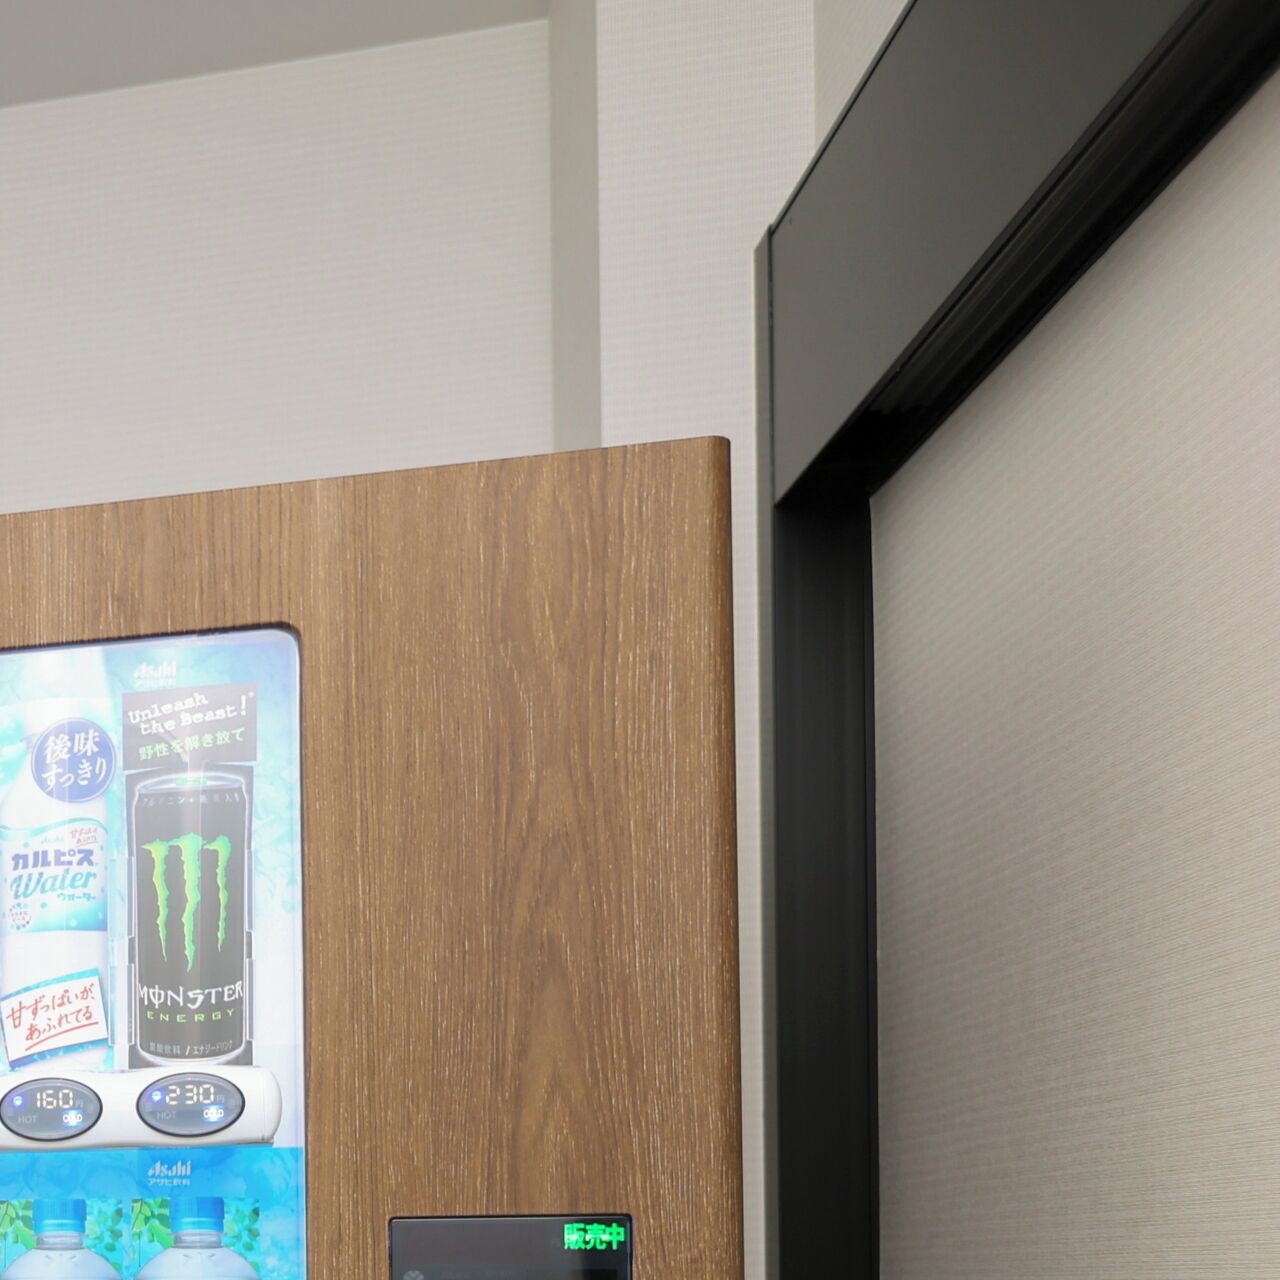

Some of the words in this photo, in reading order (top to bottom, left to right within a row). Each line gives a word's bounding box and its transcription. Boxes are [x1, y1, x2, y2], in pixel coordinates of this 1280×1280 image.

[128, 692, 209, 724] Unleash
[140, 718, 177, 736] the
[180, 695, 248, 726] Beast!
[44, 729, 101, 764] 後味
[41, 759, 108, 793] すっきり
[11, 848, 96, 871] カルピス
[9, 866, 98, 901] Water
[139, 980, 244, 1009] MONSTER
[25, 1007, 94, 1042] あふれてる
[146, 1008, 235, 1023] ENERGY
[36, 1090, 74, 1110] 160
[164, 1084, 216, 1105] 230
[563, 1222, 625, 1250] 販売中
